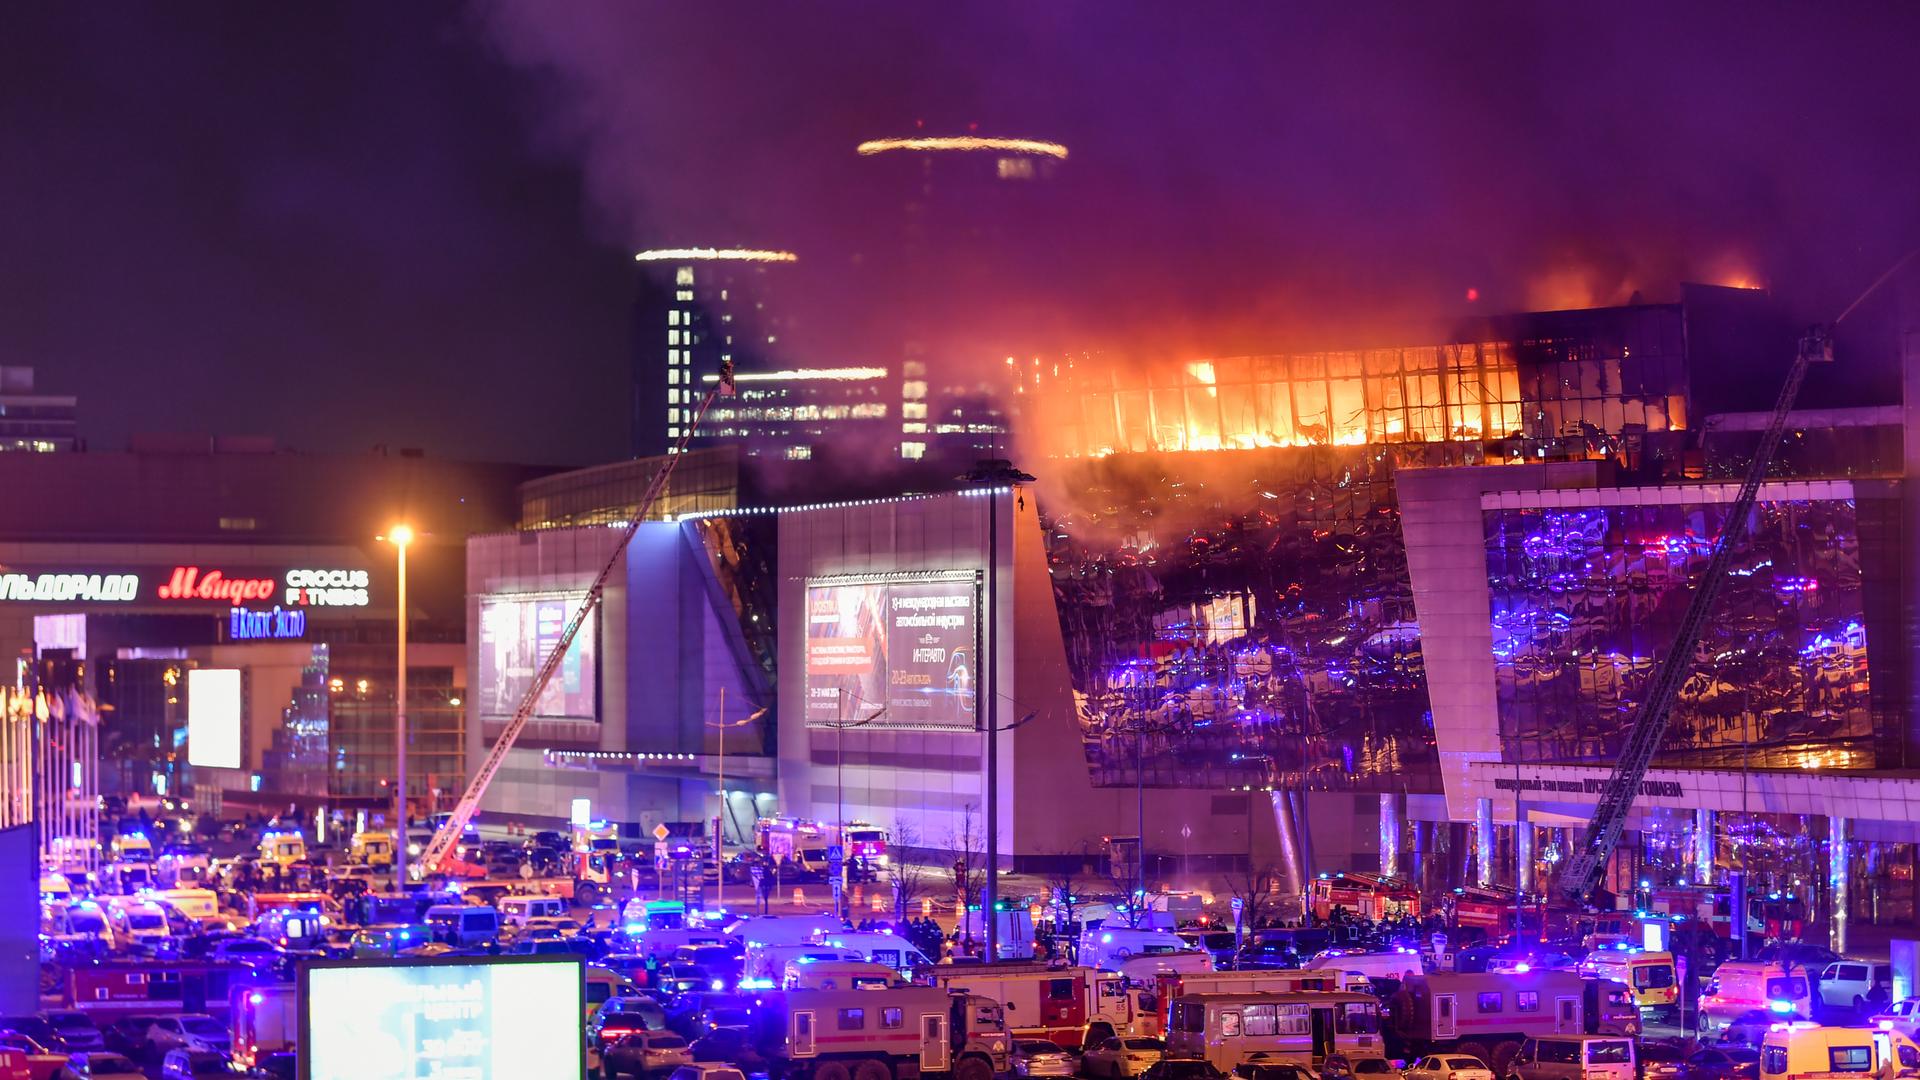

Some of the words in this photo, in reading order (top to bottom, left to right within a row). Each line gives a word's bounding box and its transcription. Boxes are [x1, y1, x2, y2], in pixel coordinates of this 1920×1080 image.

[286, 570, 369, 587] CROCUS
[0, 574, 139, 601] ЛЬДОРАДО
[286, 588, 369, 606] FITNESS
[913, 648, 946, 663] ИНТЕРАВТО
